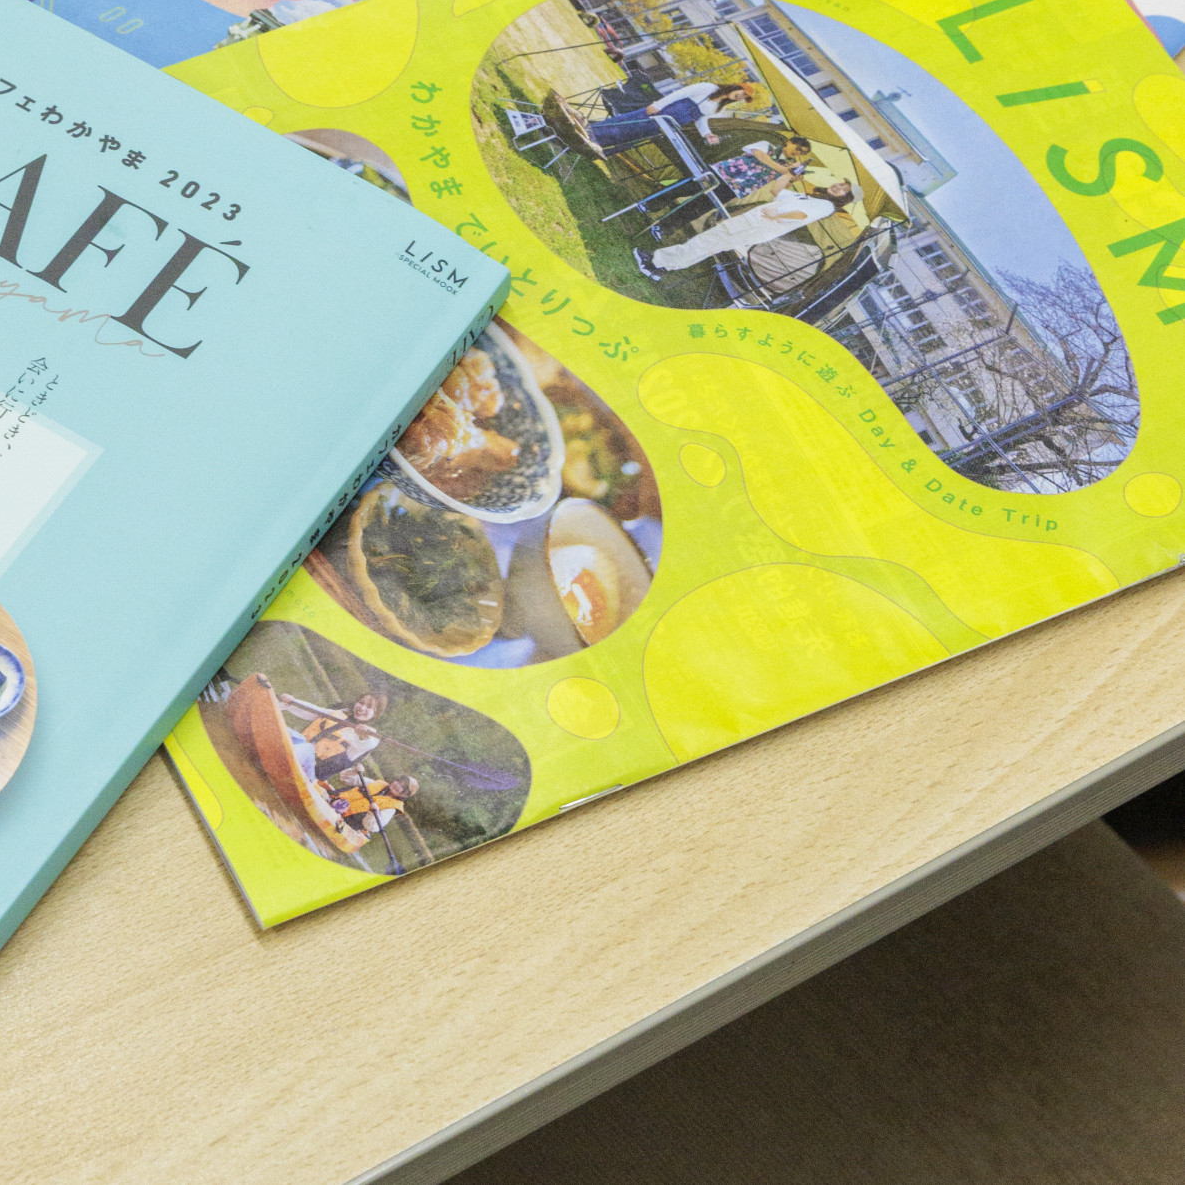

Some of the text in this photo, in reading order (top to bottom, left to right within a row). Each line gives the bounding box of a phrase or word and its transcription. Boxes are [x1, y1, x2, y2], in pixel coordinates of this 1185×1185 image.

[410, 80, 465, 200] わかやま
[158, 169, 245, 222] 2023
[397, 254, 459, 296] SPECIAL MOOK
[404, 239, 470, 289] LISM
[687, 323, 1059, 532] 暮らすように遊ぶ Day & Date Trip
